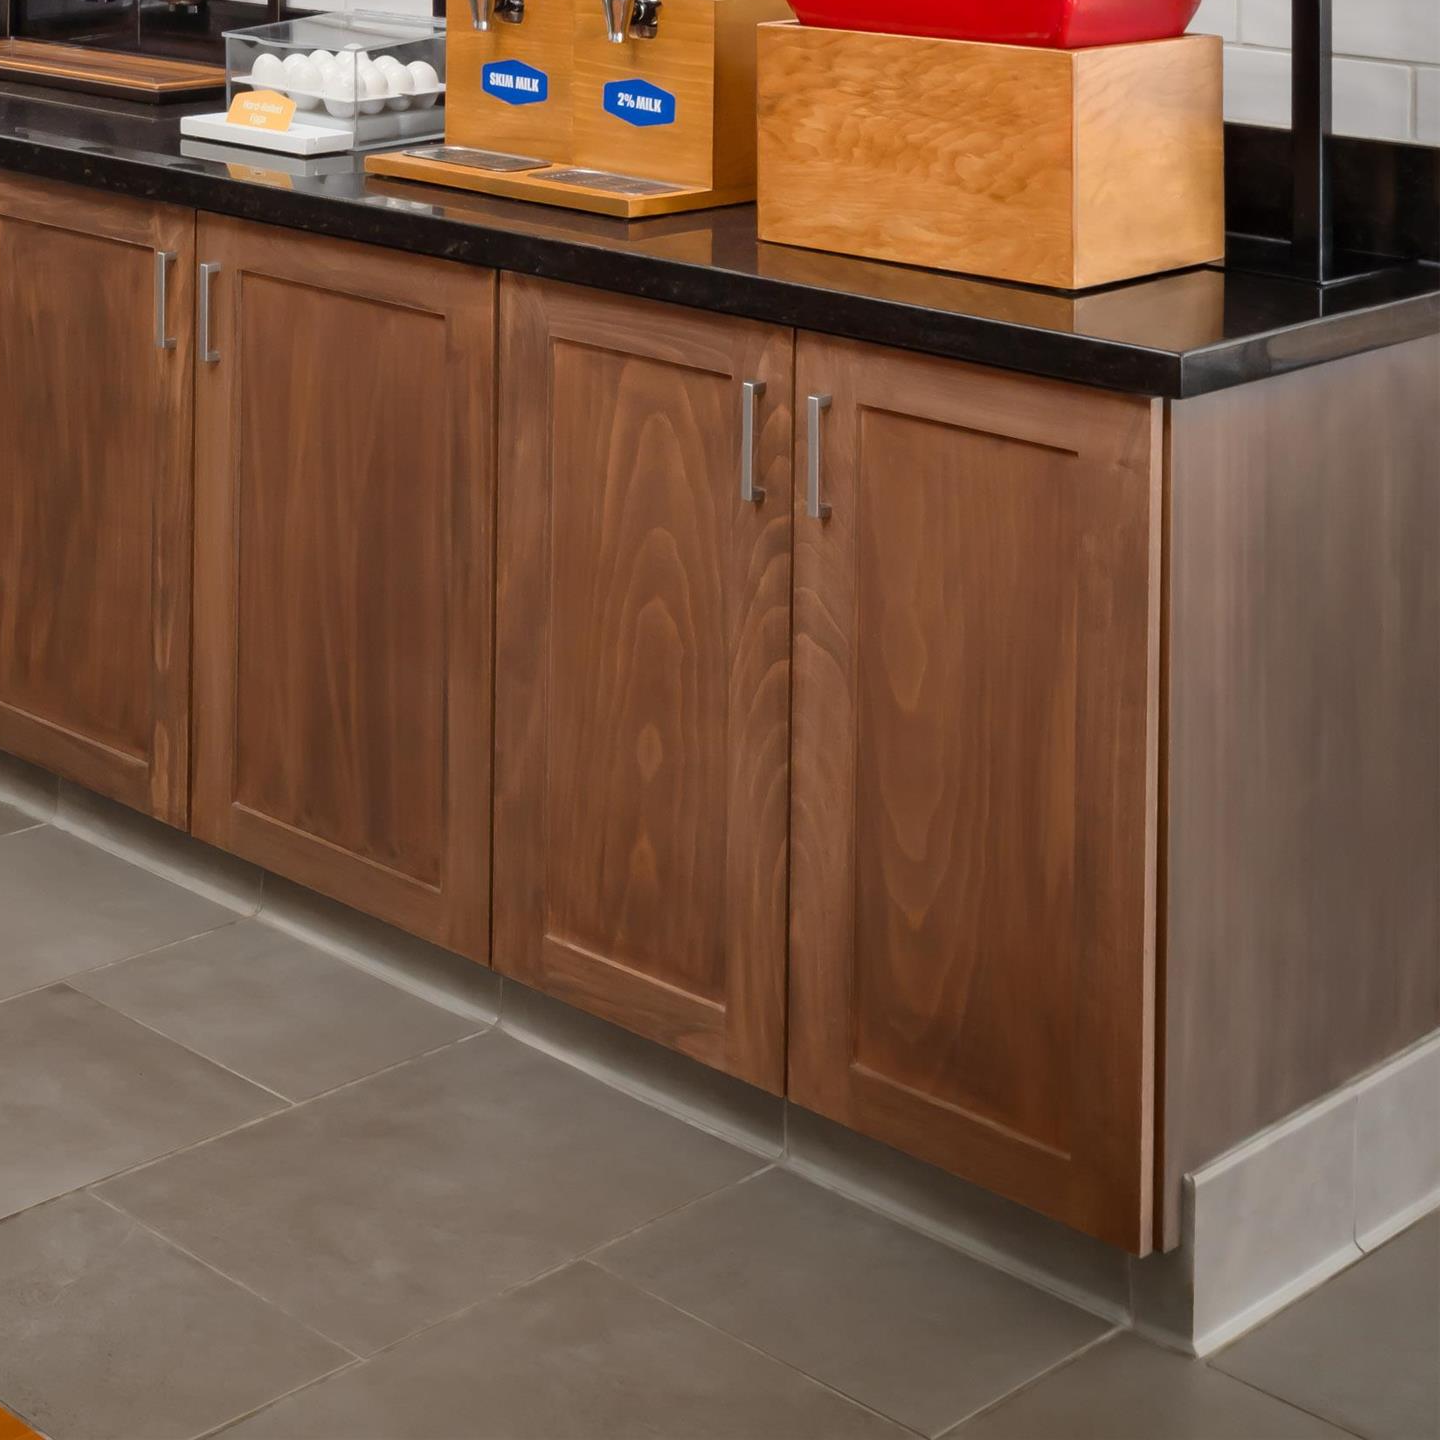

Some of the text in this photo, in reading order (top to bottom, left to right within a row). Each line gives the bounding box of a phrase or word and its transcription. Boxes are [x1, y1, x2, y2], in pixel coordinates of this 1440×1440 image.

[489, 72, 539, 93] SKIM MILK
[616, 92, 662, 113] 2% MILK
